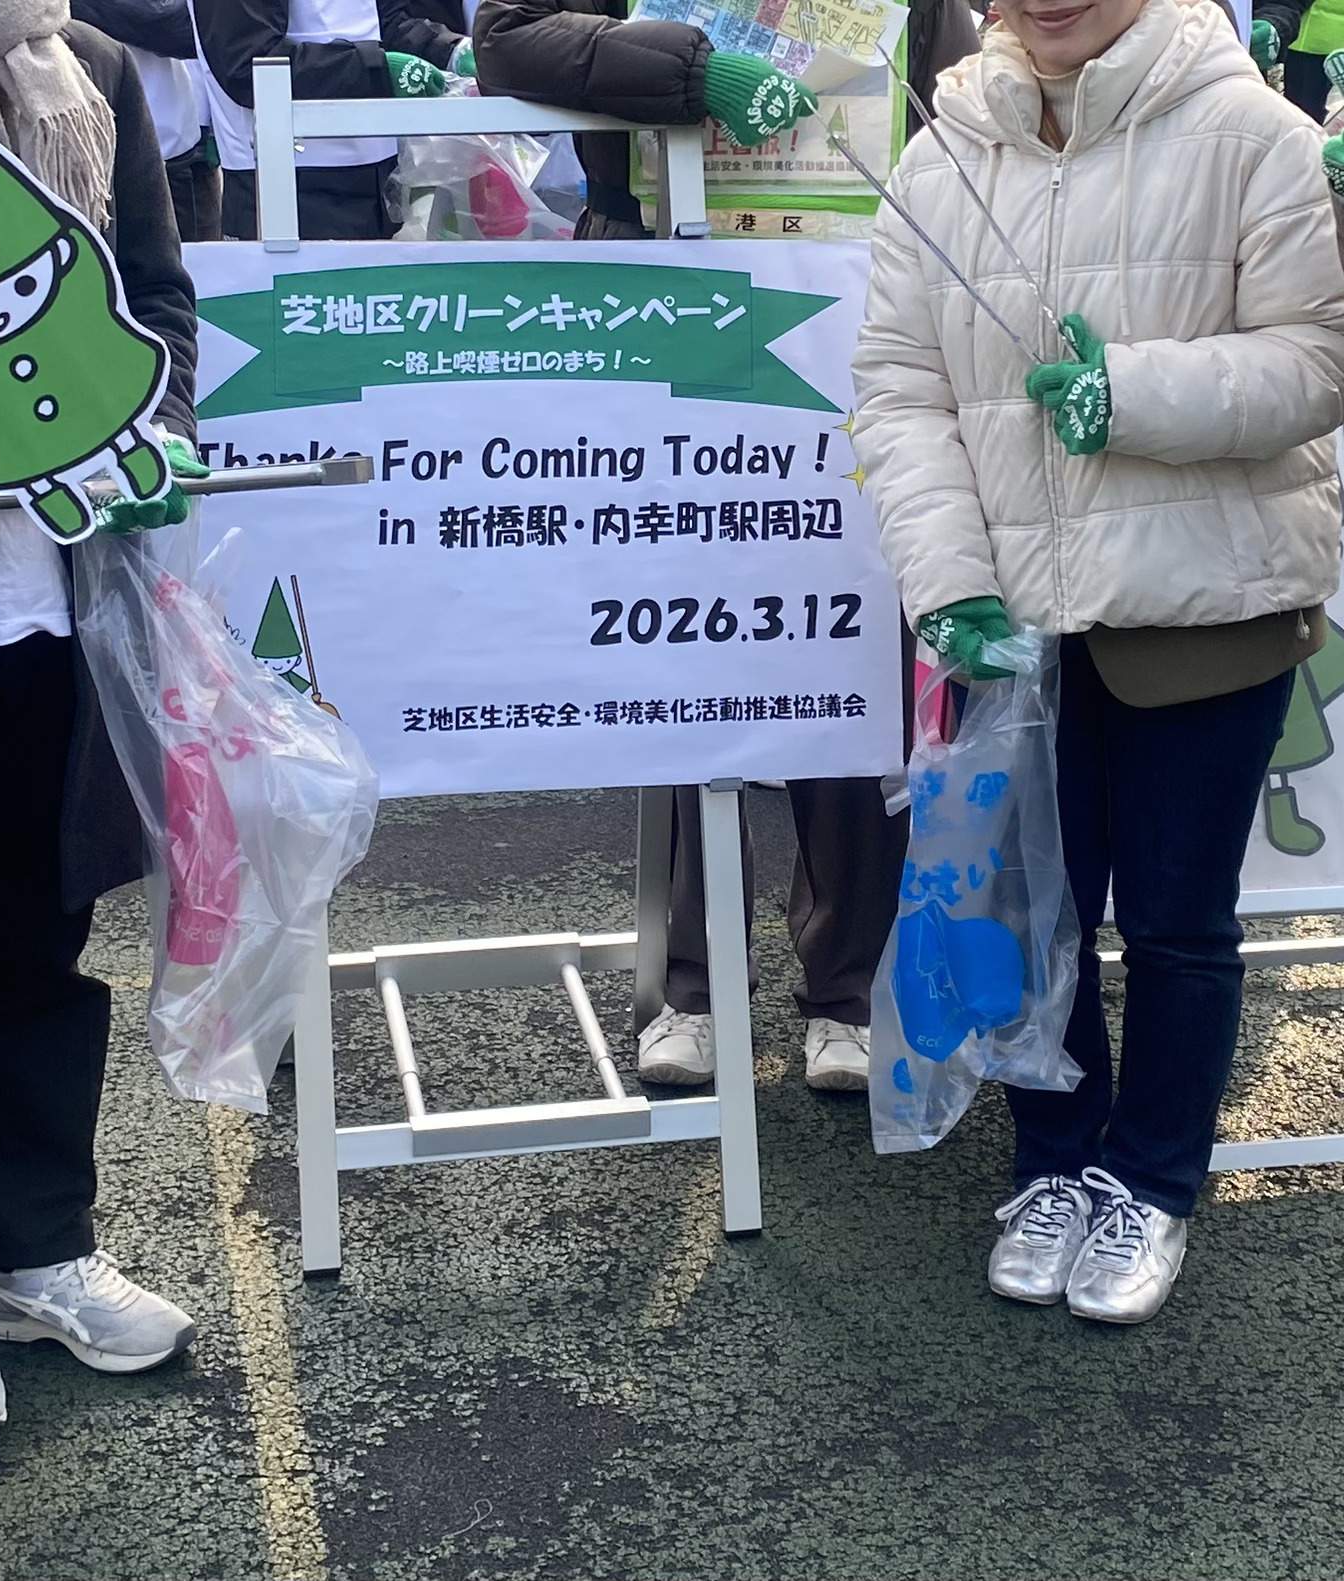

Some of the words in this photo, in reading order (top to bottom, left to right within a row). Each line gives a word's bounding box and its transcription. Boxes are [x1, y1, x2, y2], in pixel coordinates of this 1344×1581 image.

[410, 68, 423, 82] 48
[747, 76, 779, 125] ecology
[767, 95, 785, 118] 48
[281, 294, 748, 335] 芝地区クリーンキャンペーン
[382, 439, 463, 482] For
[482, 437, 646, 482] Coming
[378, 508, 416, 546] in
[438, 498, 844, 550] 新橋駅・内幸町駅周辺
[589, 592, 863, 647] 2026.3.12
[401, 692, 868, 733] 芝地区生活安全・環境美化活動推進協議会
